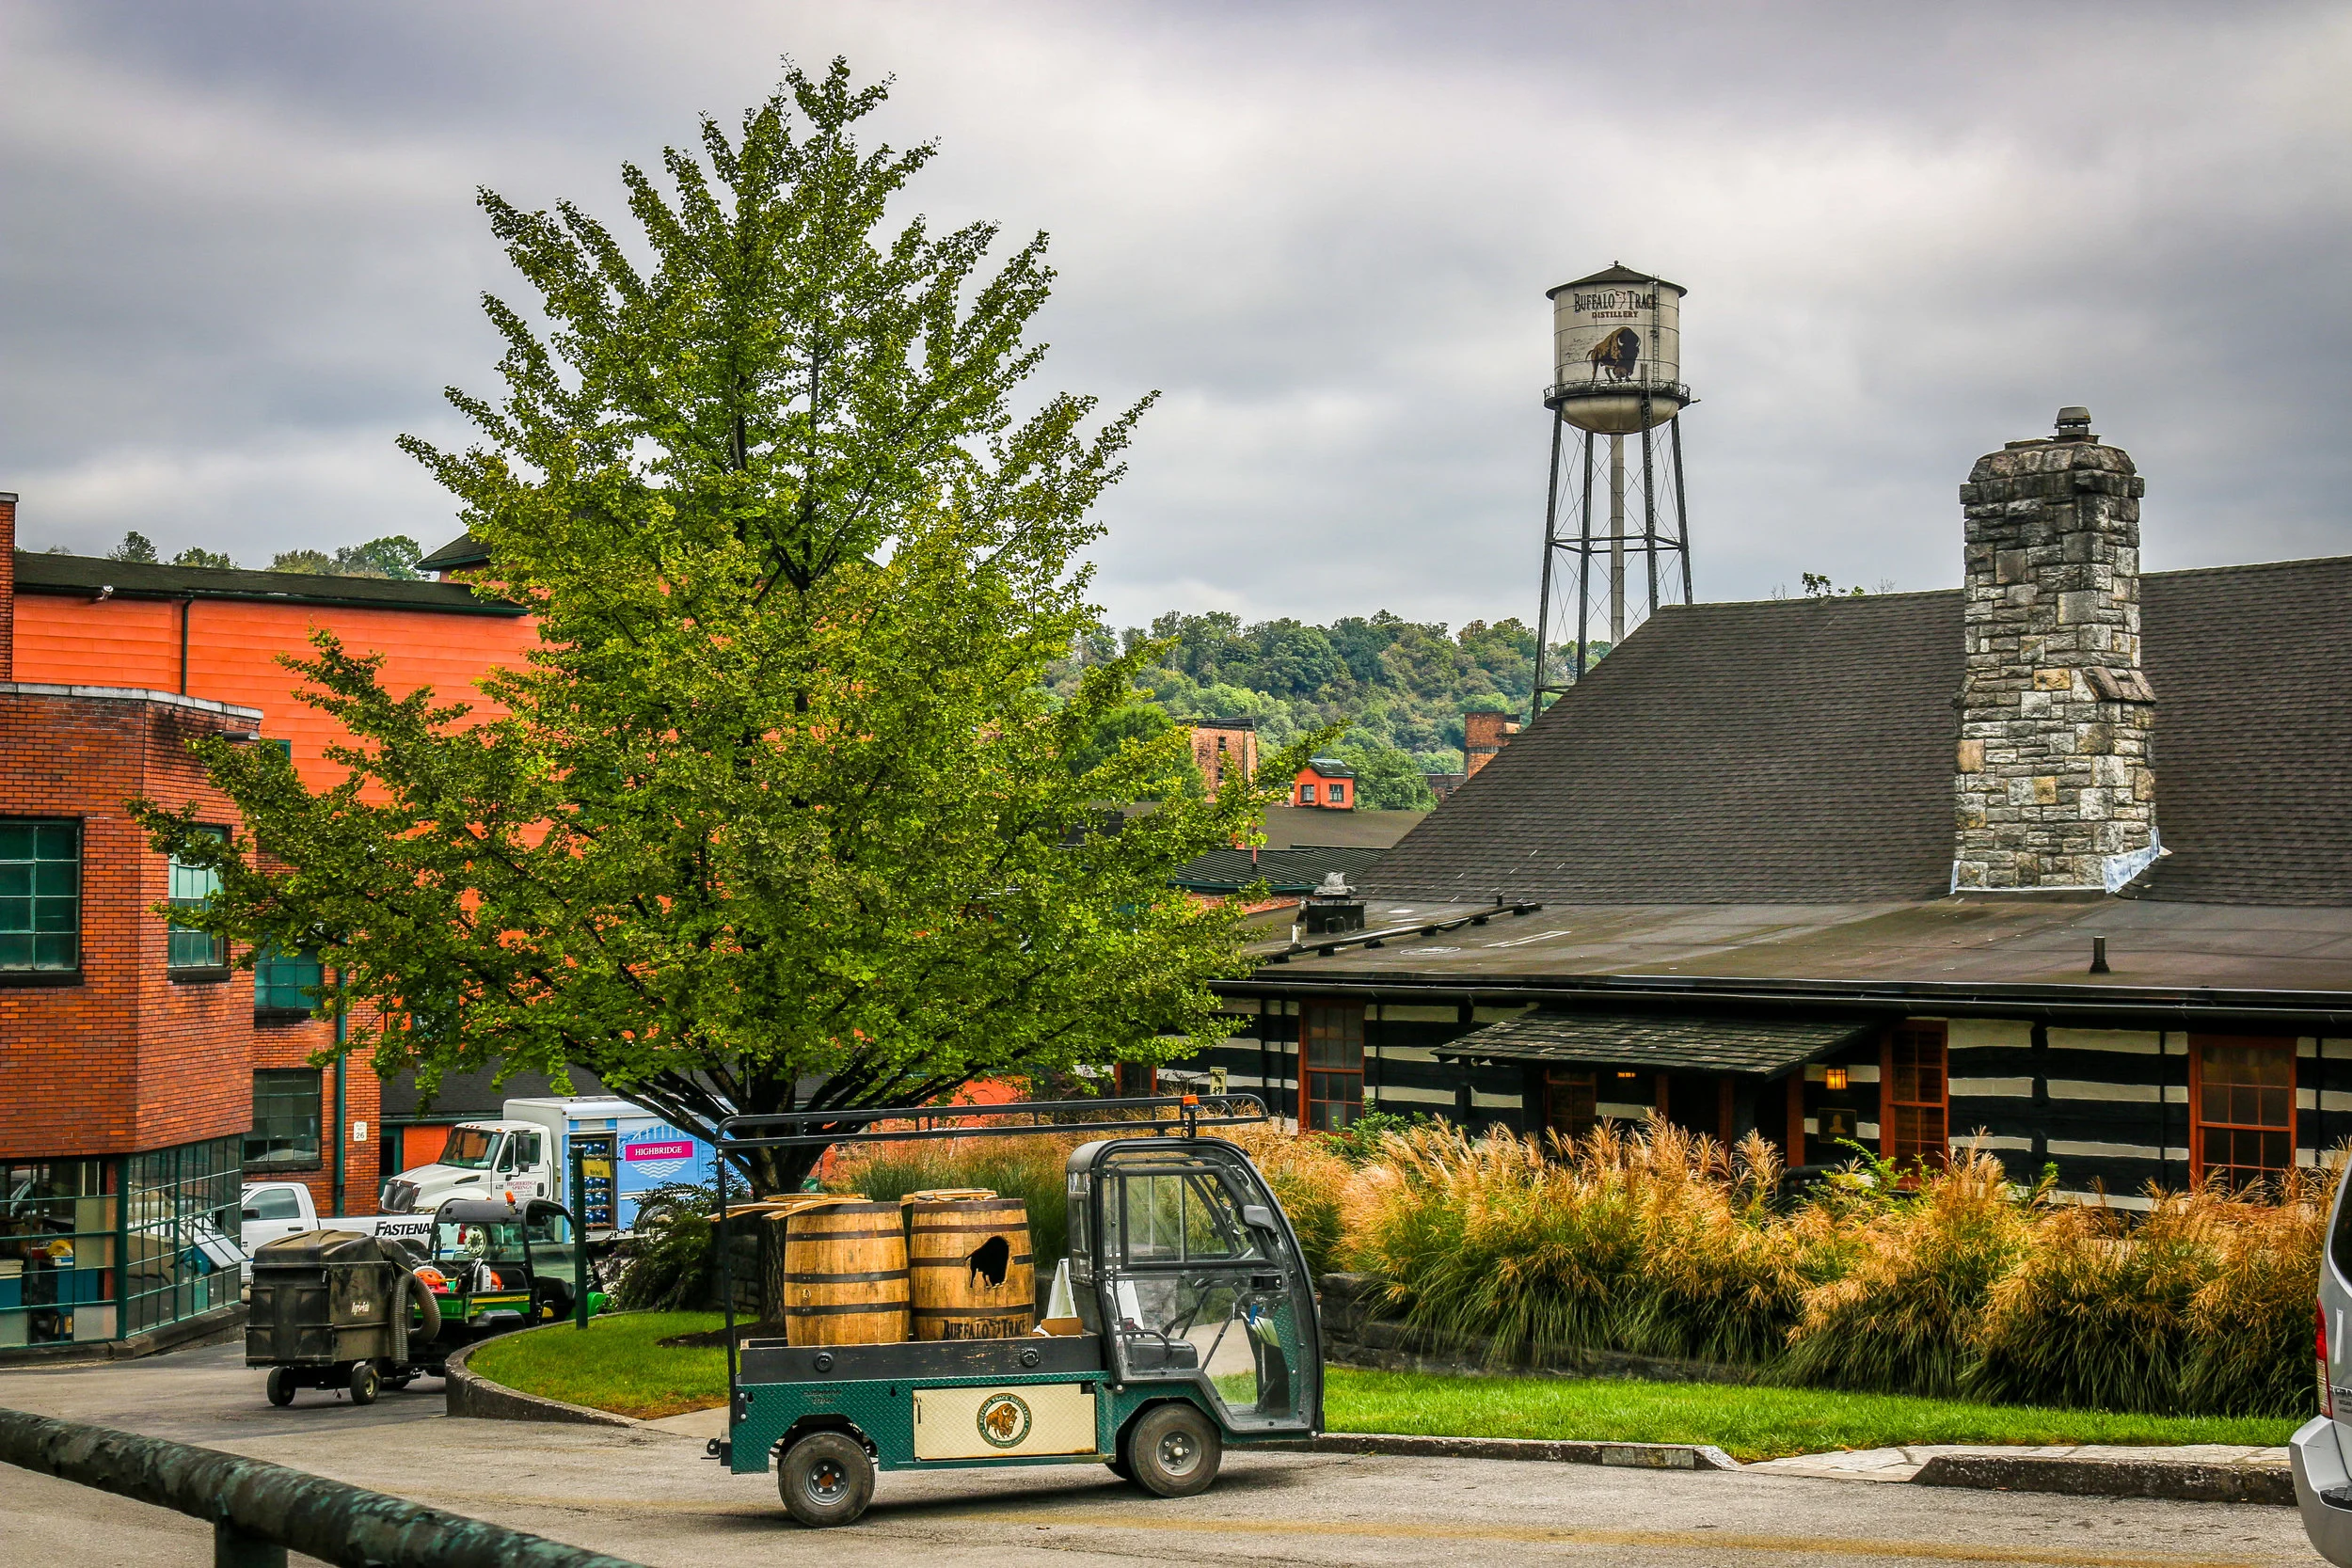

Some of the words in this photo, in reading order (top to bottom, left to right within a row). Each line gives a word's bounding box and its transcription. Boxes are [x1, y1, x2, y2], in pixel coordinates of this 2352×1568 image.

[1574, 293, 1615, 313] BUFFALO
[1591, 310, 1639, 319] DISTILLERY
[634, 1146, 683, 1156] HIGHBRIDGE
[374, 1221, 433, 1237] FASTENA
[943, 1319, 990, 1340] BUFFALO
[1000, 1319, 1026, 1339] TRACE
